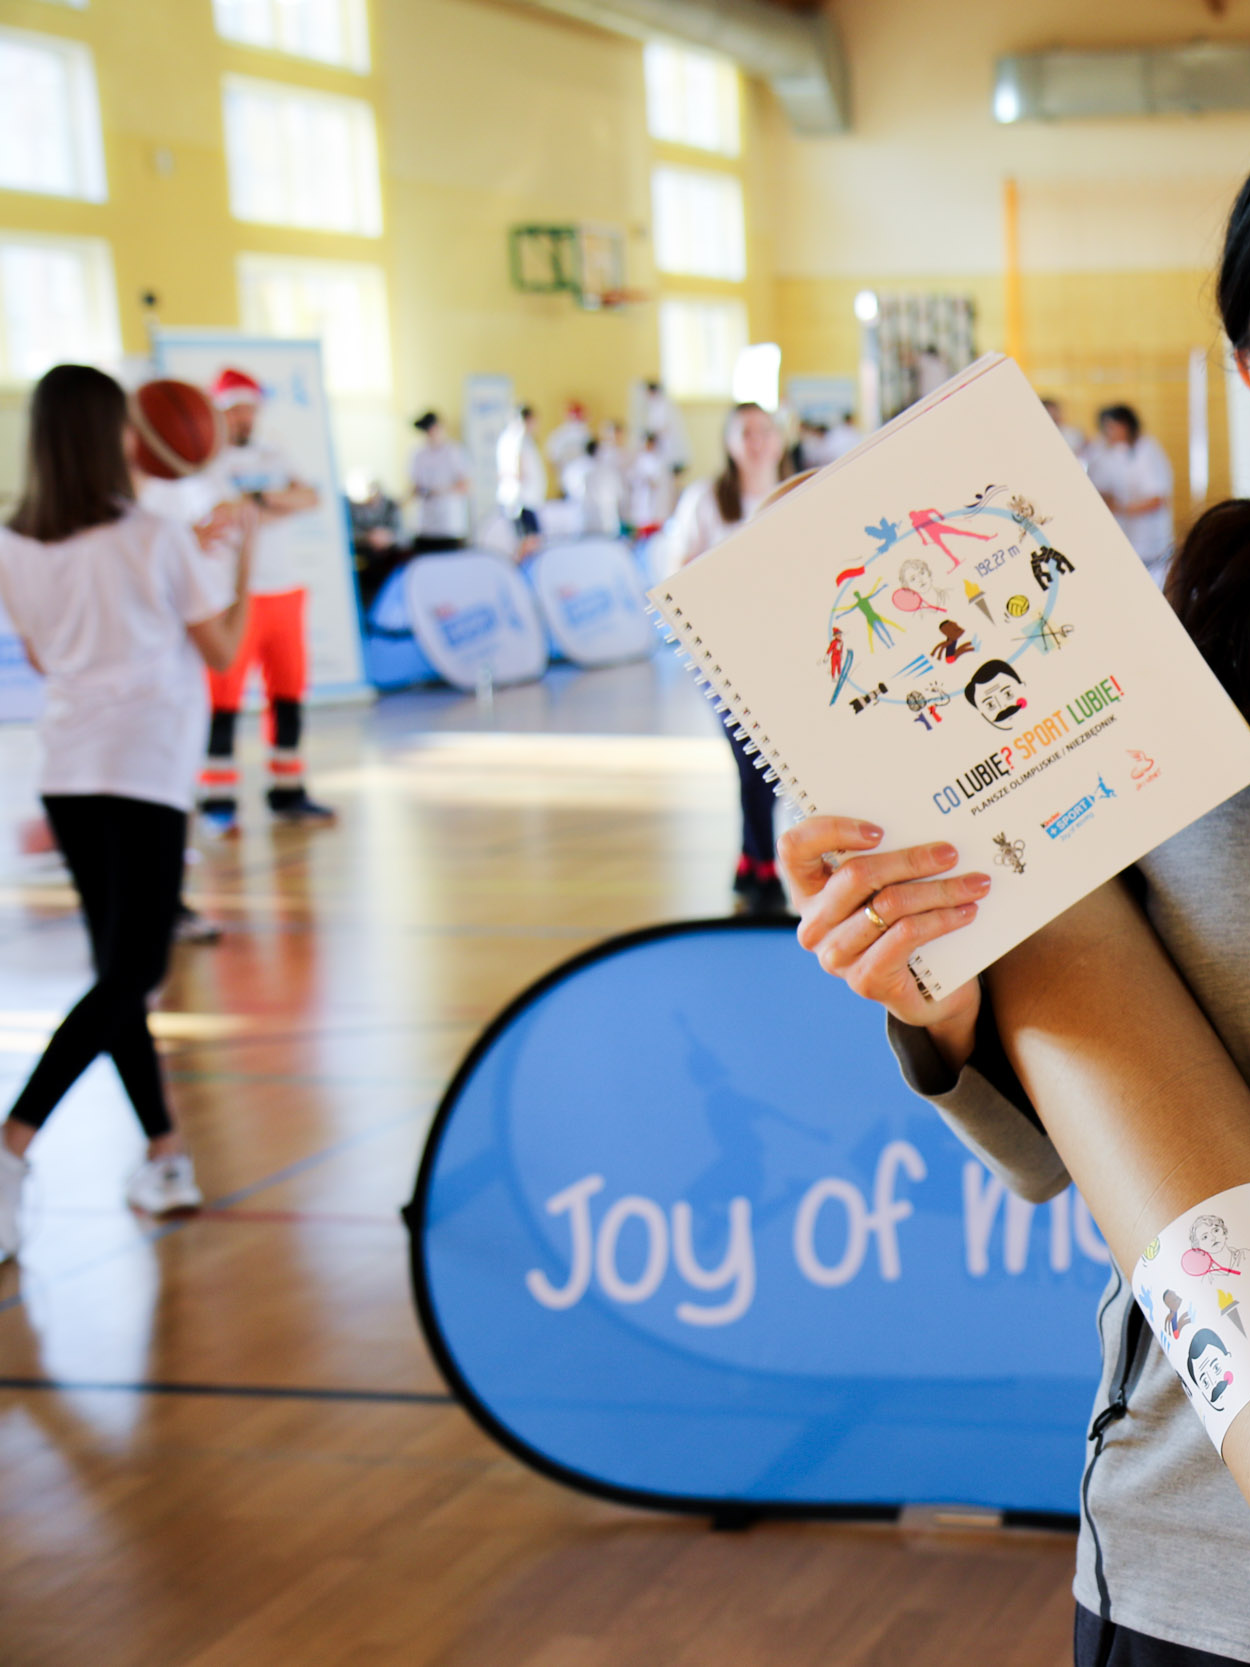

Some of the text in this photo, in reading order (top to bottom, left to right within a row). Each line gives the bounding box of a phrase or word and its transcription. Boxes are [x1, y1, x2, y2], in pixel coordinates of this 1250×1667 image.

[932, 675, 1125, 815] CO LUBIĘ? SPORT LUBIĘ!
[971, 788, 1010, 816] PLANSZE
[1066, 714, 1117, 753] NIEZBĘDNIK
[525, 1172, 757, 1327] Joy
[793, 1139, 928, 1288] of
